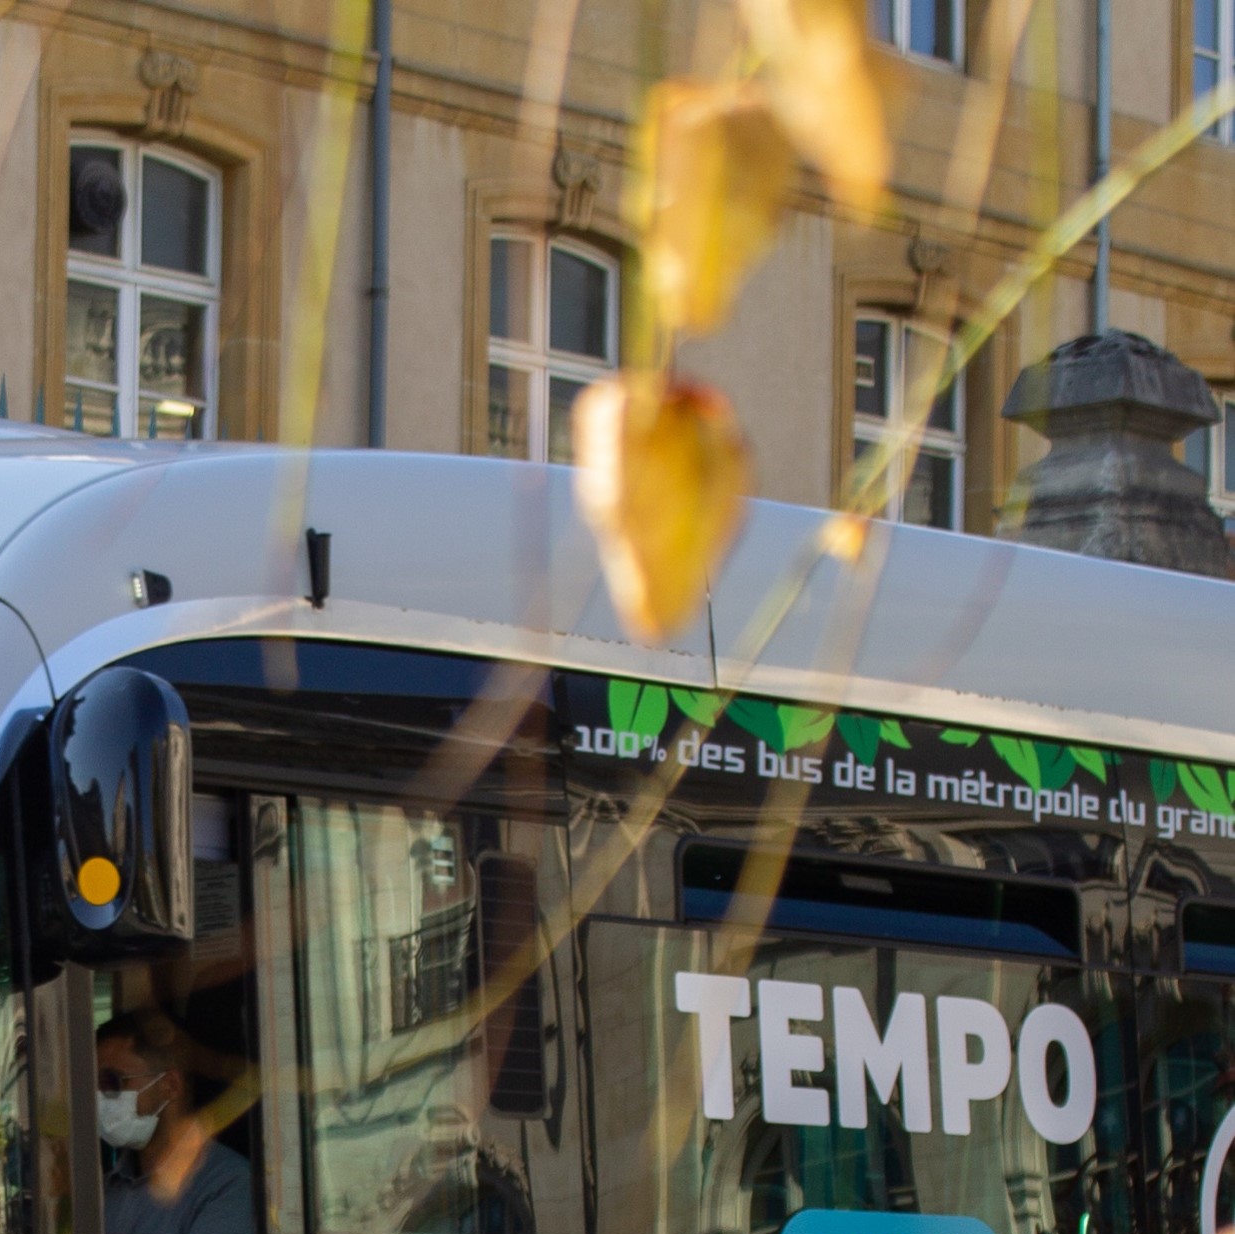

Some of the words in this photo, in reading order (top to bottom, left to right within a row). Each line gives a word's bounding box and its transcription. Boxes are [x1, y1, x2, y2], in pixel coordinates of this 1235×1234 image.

[574, 725, 667, 762] 100%
[677, 730, 746, 774] des
[757, 740, 823, 784] bus
[833, 752, 876, 791] de
[885, 757, 916, 796] la
[927, 769, 1100, 823] métropole
[1108, 788, 1146, 827] du
[674, 970, 1098, 1145] TEMPO
